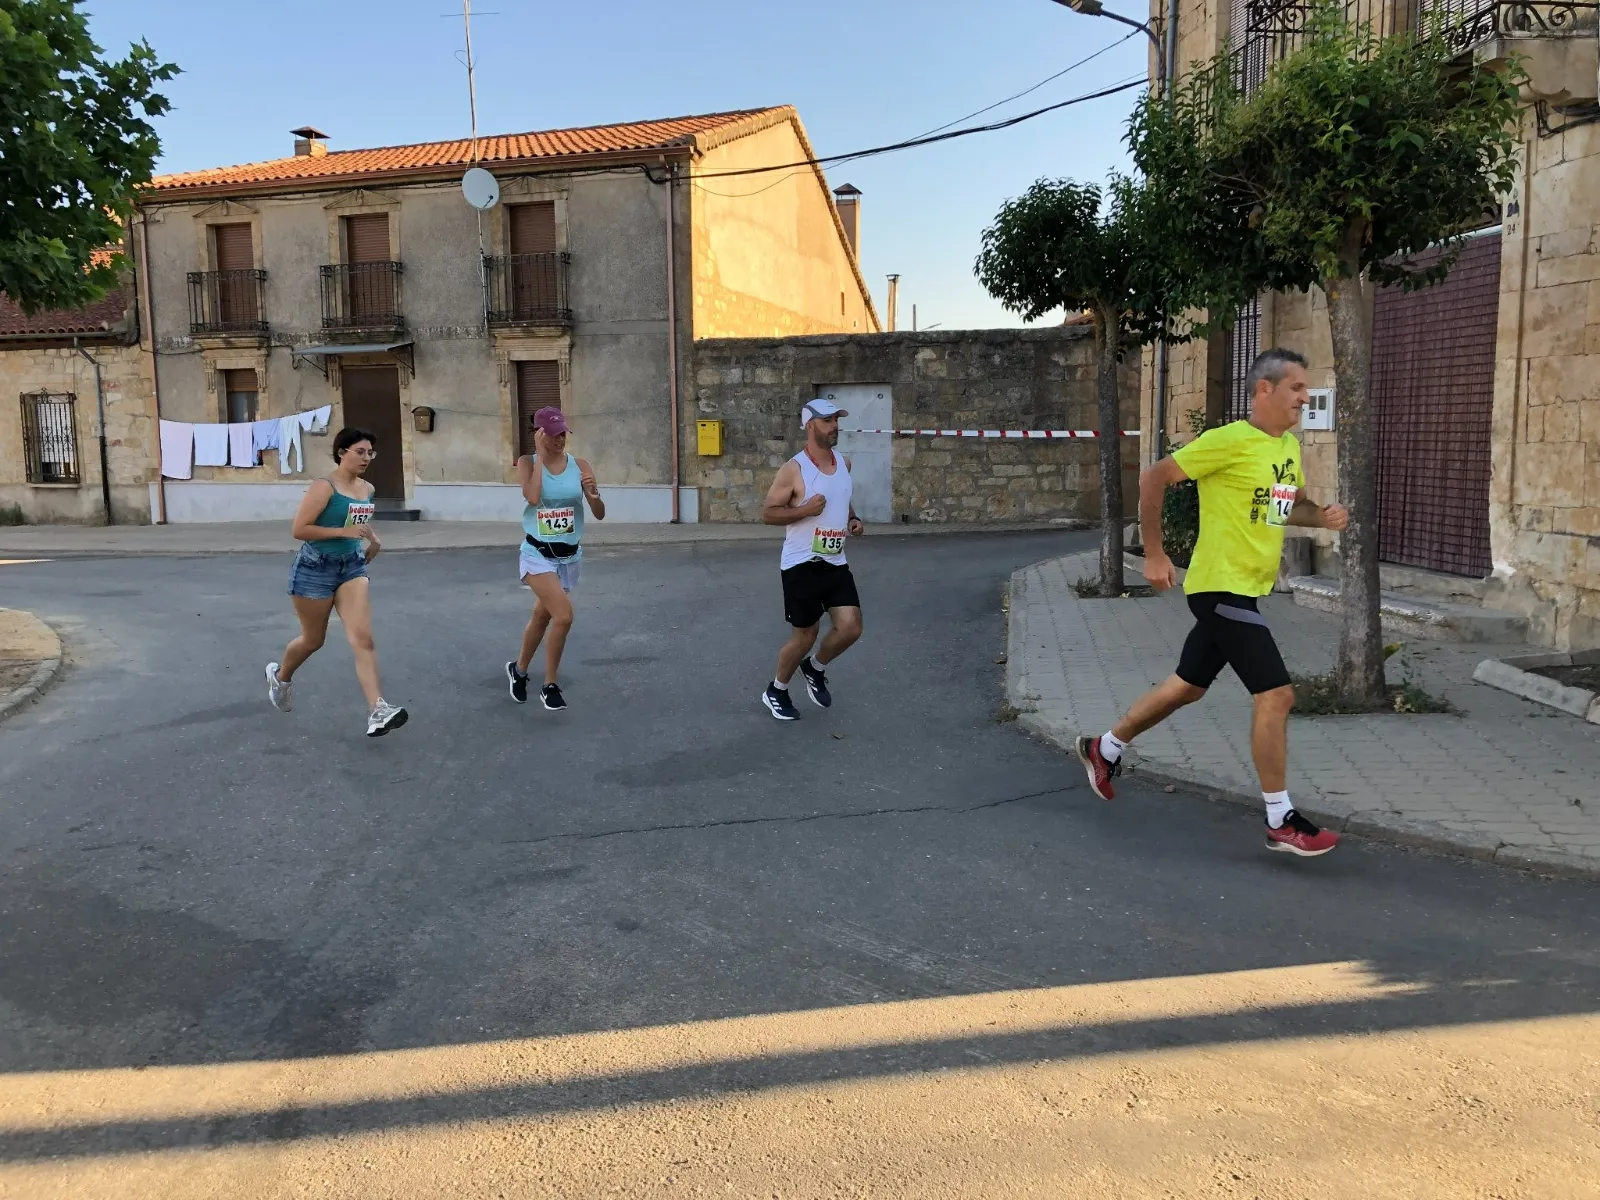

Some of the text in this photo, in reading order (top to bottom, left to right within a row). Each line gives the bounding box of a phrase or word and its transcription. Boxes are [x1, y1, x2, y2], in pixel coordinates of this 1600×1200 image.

[352, 514, 368, 525] 152
[537, 509, 574, 520] bedunia
[545, 517, 568, 530] 143
[821, 537, 841, 548] 135
